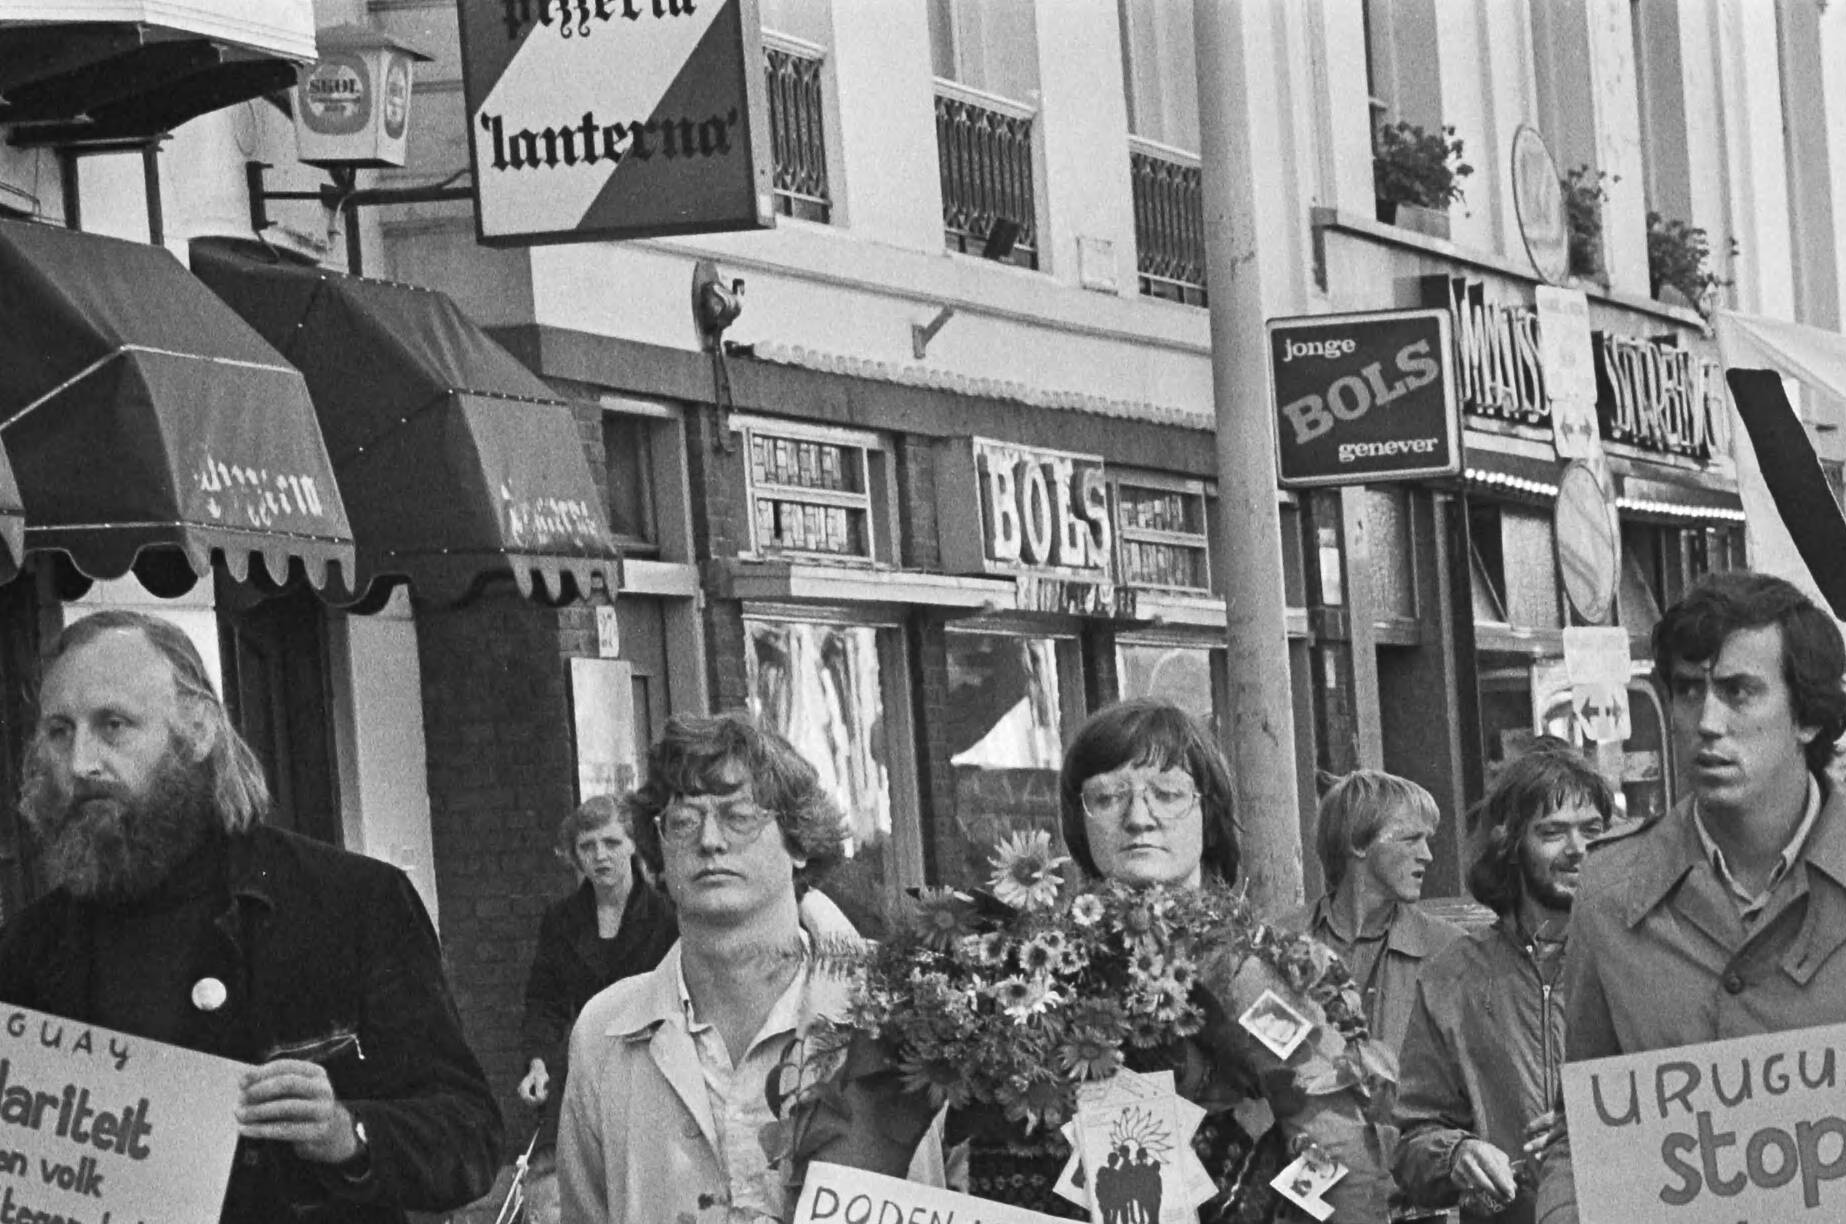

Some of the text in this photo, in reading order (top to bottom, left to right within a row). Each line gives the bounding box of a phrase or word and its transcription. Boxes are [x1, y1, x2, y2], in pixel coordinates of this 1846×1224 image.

[1283, 338, 1356, 362] jonge
[1282, 338, 1440, 445] BOLS
[1338, 437, 1439, 463] genever
[986, 450, 1112, 568] BOLS
[41, 1155, 104, 1198] volk
